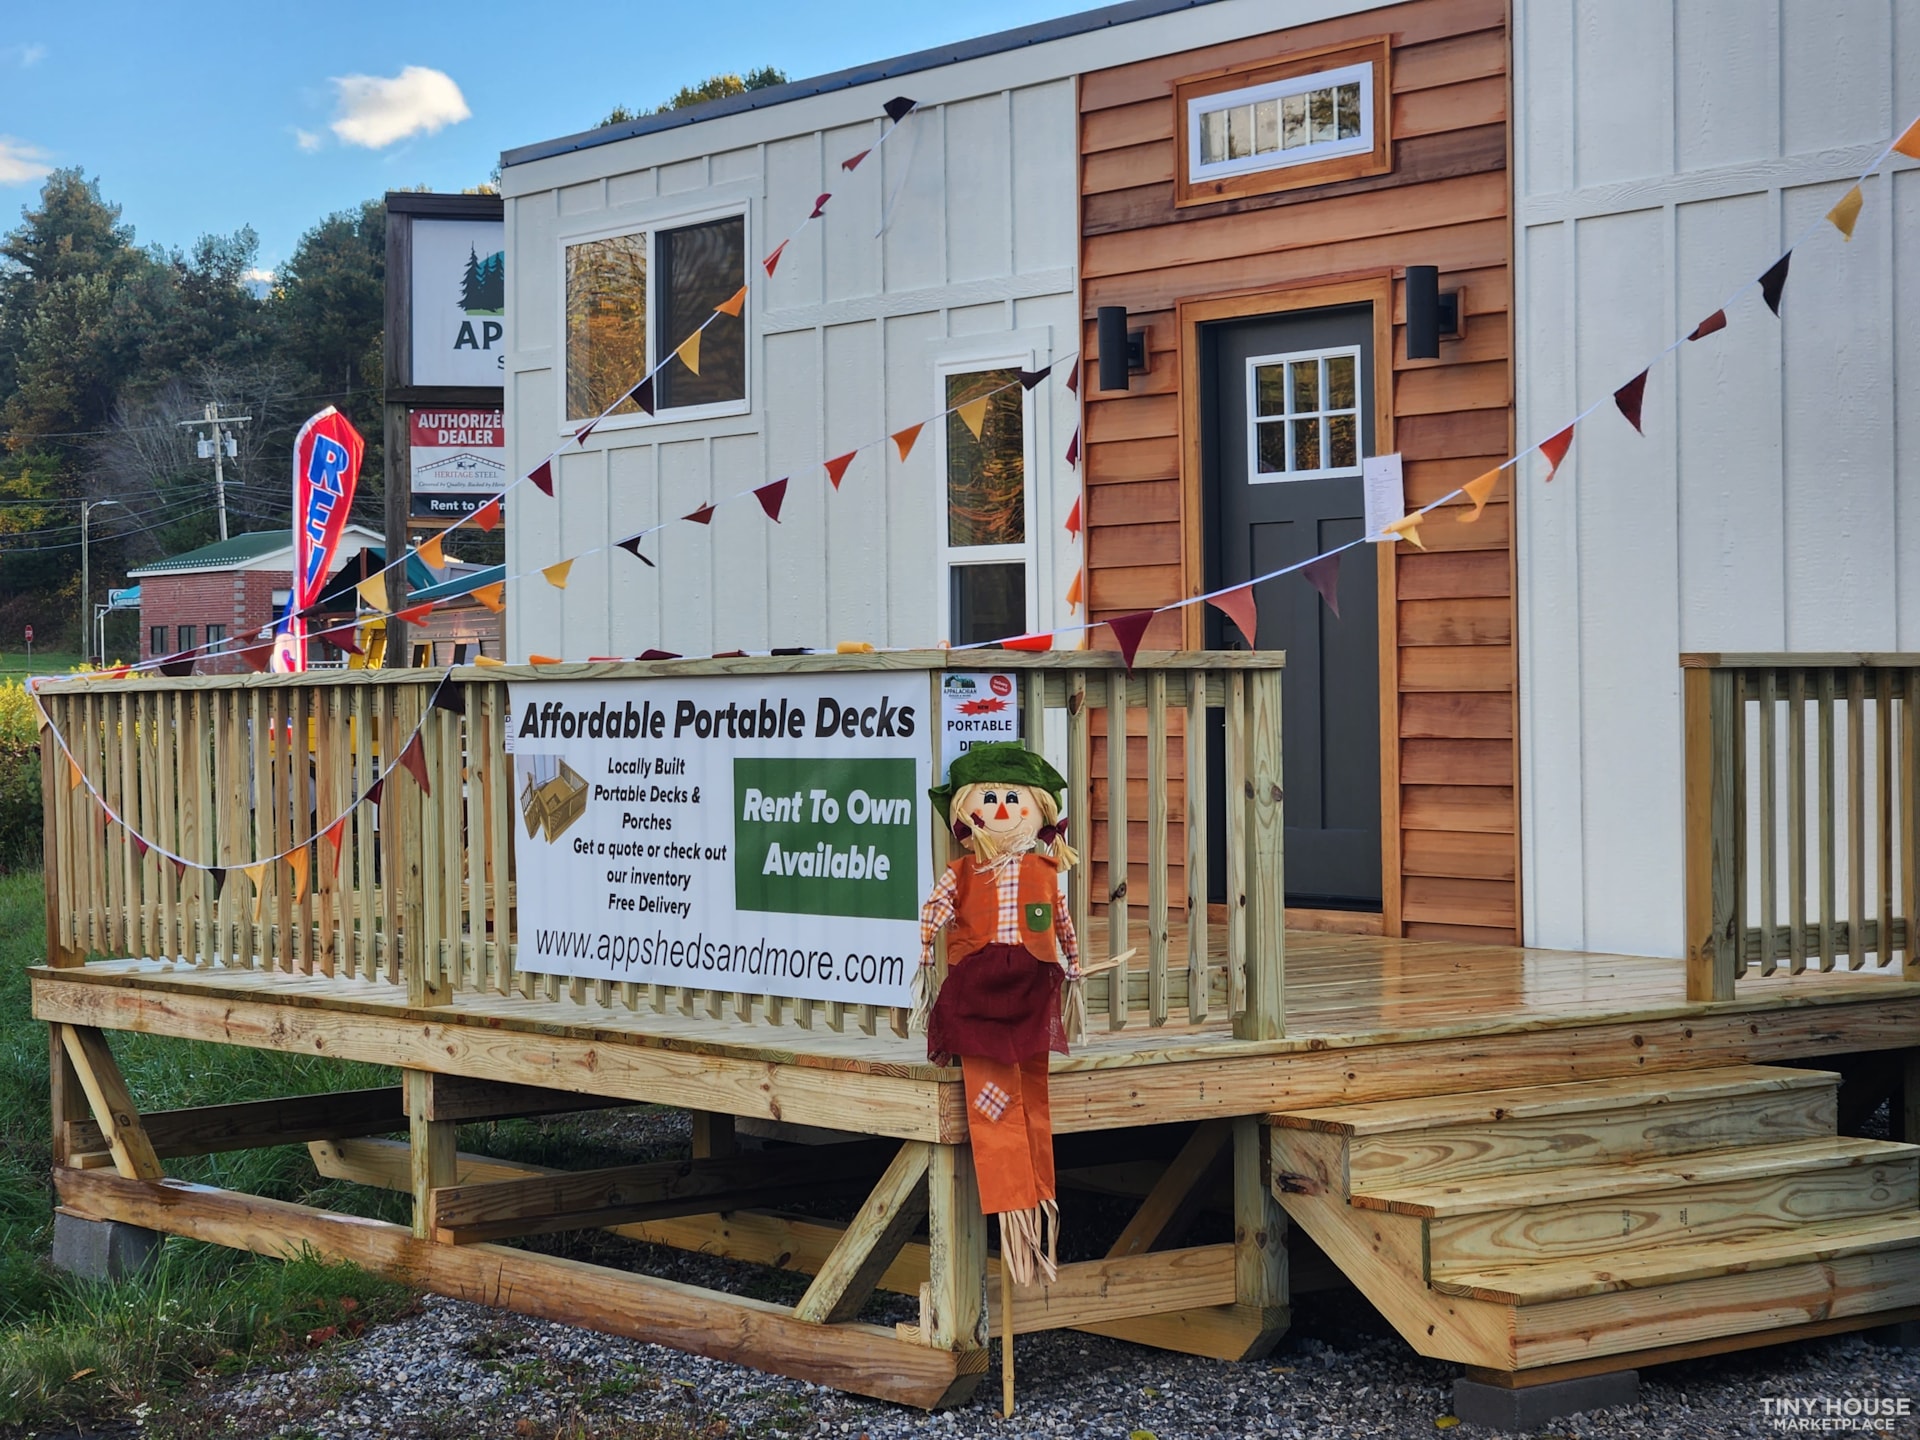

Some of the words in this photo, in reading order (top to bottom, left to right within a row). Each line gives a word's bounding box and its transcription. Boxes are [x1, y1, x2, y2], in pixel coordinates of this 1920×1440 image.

[418, 413, 505, 428] AUTHORIZE
[438, 430, 493, 444] DEALER
[434, 471, 473, 479] HERITAGE
[475, 471, 499, 479] STEEL
[431, 500, 459, 510] Rent
[462, 501, 475, 510] to
[518, 701, 665, 739] Affordable
[674, 699, 805, 738] Portable
[815, 696, 915, 738] Decks
[947, 720, 1012, 731] PORTABLE
[608, 757, 650, 778] Locally
[655, 757, 685, 775] Built
[594, 784, 646, 801] Portable
[650, 785, 688, 803] Decks
[691, 786, 701, 803] &
[743, 788, 803, 823] Rent
[809, 789, 839, 824] To
[847, 789, 912, 825] Own
[622, 812, 672, 830] Porches
[573, 837, 594, 854] Get
[597, 843, 605, 855] a
[608, 841, 643, 860] quote
[647, 845, 660, 858] or
[663, 842, 701, 860] check
[704, 845, 727, 861] out
[762, 841, 891, 881] Available
[607, 870, 627, 883] our
[631, 866, 691, 892] inventory
[608, 893, 635, 911] Free
[639, 895, 691, 919] Delivery
[536, 929, 904, 986] www.appshedsandmore.com
